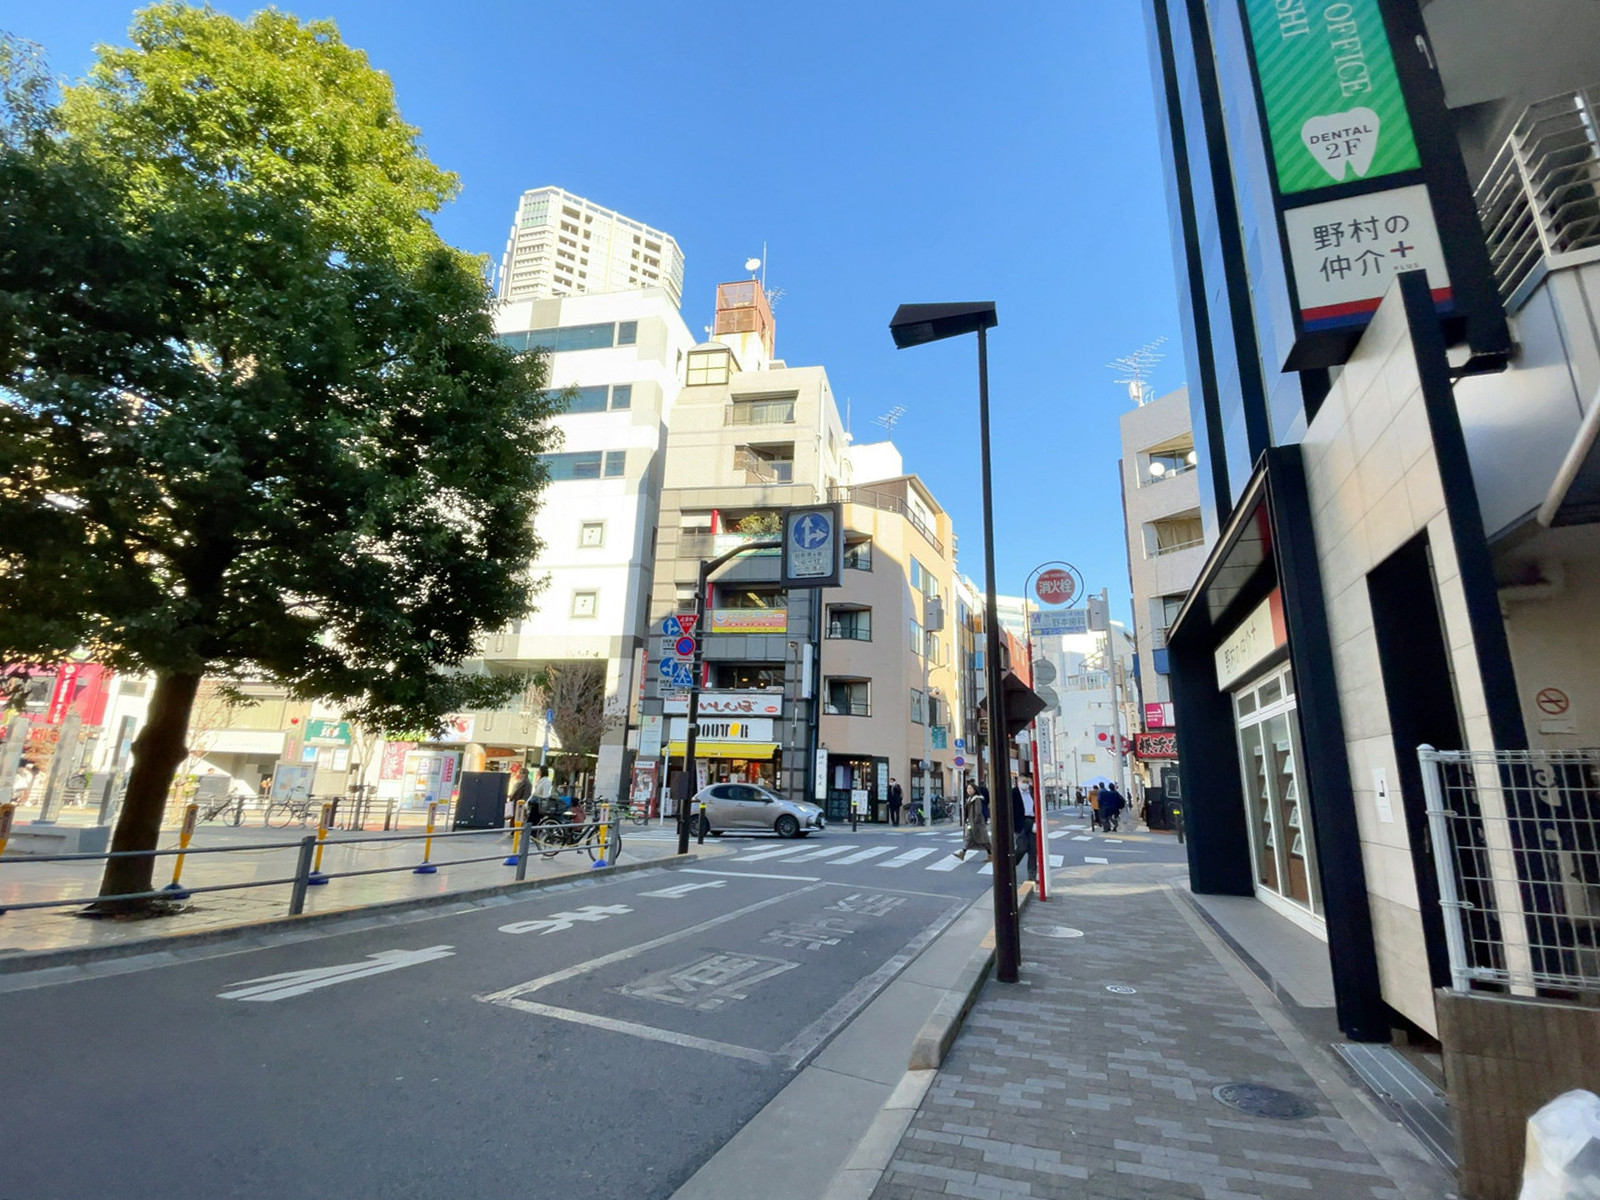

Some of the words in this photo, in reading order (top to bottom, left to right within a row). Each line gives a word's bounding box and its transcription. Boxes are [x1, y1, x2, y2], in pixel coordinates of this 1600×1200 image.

[1324, 3, 1372, 97] OFFICE
[1310, 125, 1372, 144] DENTAL
[1325, 138, 1361, 160] 2F
[1313, 215, 1409, 251] 野村の
[1038, 579, 1073, 595] 消火栓
